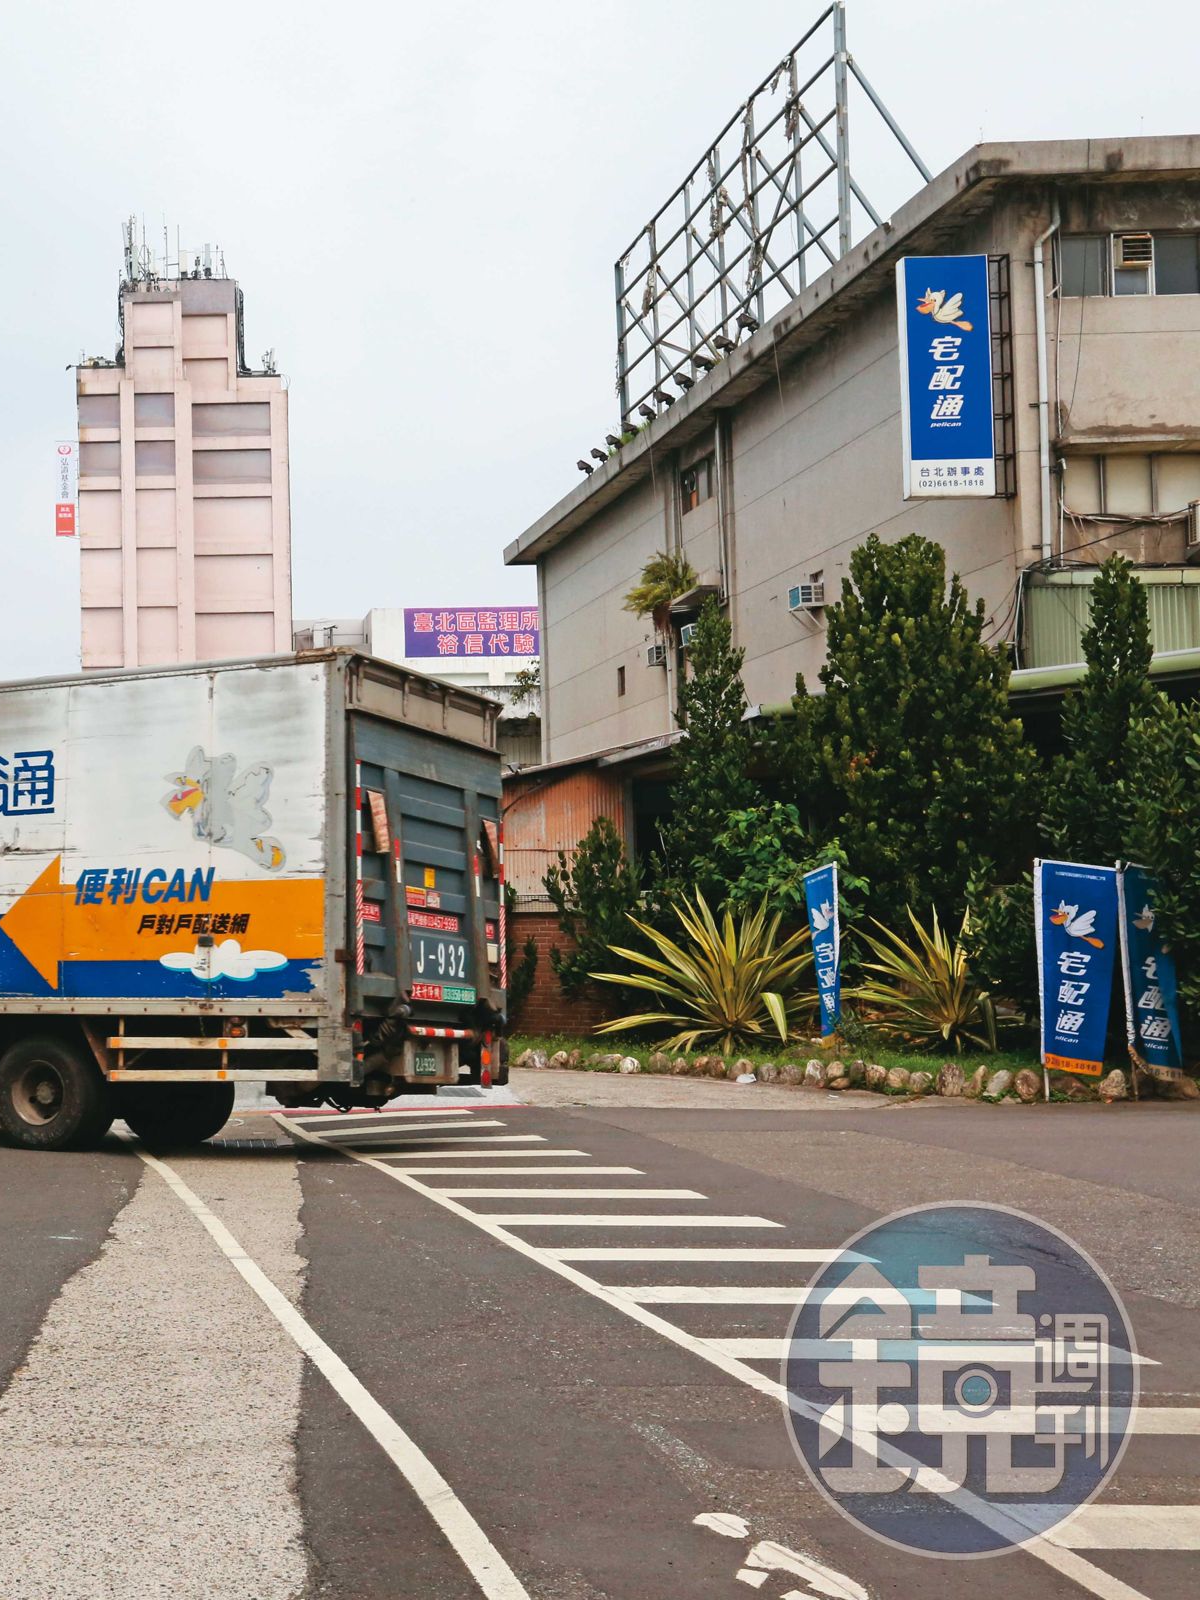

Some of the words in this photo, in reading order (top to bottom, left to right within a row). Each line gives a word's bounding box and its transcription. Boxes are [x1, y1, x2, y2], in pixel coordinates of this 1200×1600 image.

[928, 336, 964, 420] 宅配通
[918, 479, 985, 488] (02)6618-1818
[413, 611, 539, 632] 臺北區監理所
[437, 634, 535, 654] 裕信代驗
[75, 867, 216, 905] 便利CAN
[408, 940, 465, 978] J-932
[1056, 951, 1092, 1036] 宅配通
